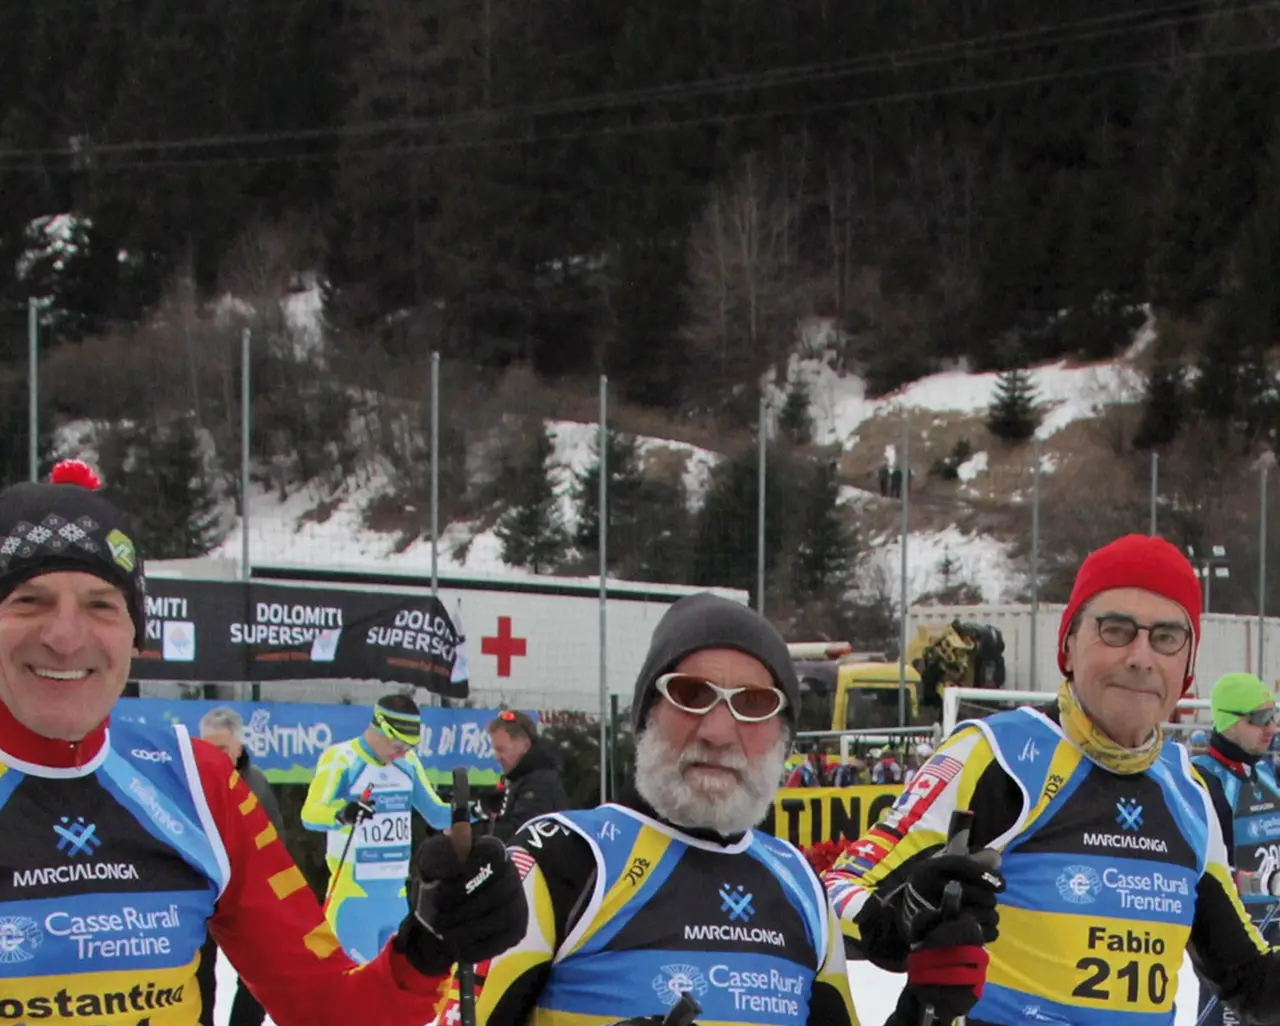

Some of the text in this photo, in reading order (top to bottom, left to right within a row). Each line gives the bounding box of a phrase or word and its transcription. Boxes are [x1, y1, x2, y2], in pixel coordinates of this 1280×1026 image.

[256, 602, 343, 627] DOLOMITI
[1083, 833, 1168, 853] MARCIALONGA
[13, 863, 139, 887] MARCIALONGA
[1103, 868, 1188, 896] Casse Rurali
[1118, 887, 1182, 914] Trentine
[44, 905, 180, 937] Casse Rurali
[76, 934, 171, 960] Trentine
[684, 925, 785, 946] MARCIALONGA
[1088, 926, 1166, 956] Fabio
[708, 965, 768, 988] Casse
[1072, 957, 1168, 1005] 210
[729, 988, 798, 1015] Trentine
